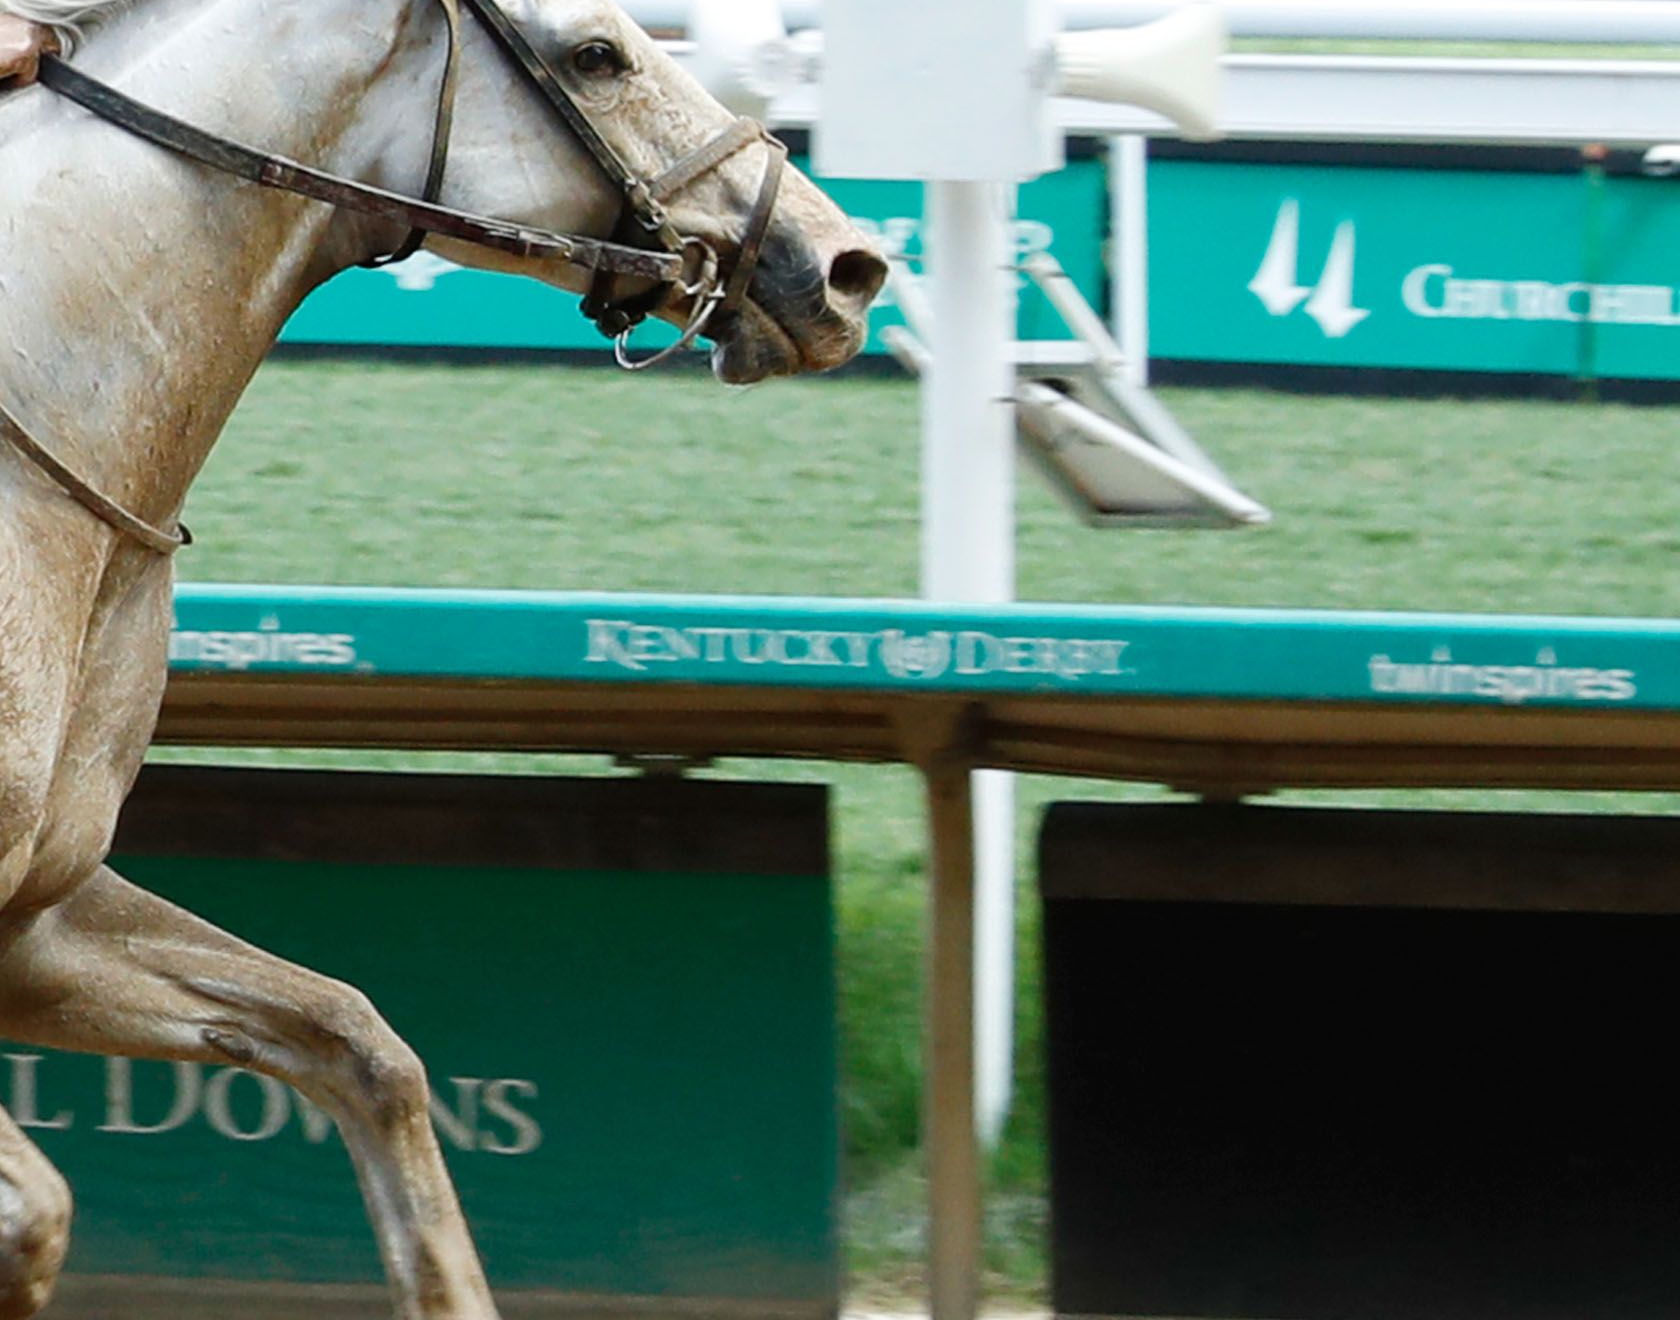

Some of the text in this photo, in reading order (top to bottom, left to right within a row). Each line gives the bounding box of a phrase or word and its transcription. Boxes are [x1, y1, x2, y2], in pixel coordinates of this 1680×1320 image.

[1401, 263, 1680, 326] CHURCHIL
[170, 613, 356, 670] nspires
[585, 619, 1131, 679] KENTUCKY DERBY
[1367, 644, 1637, 706] twinspires
